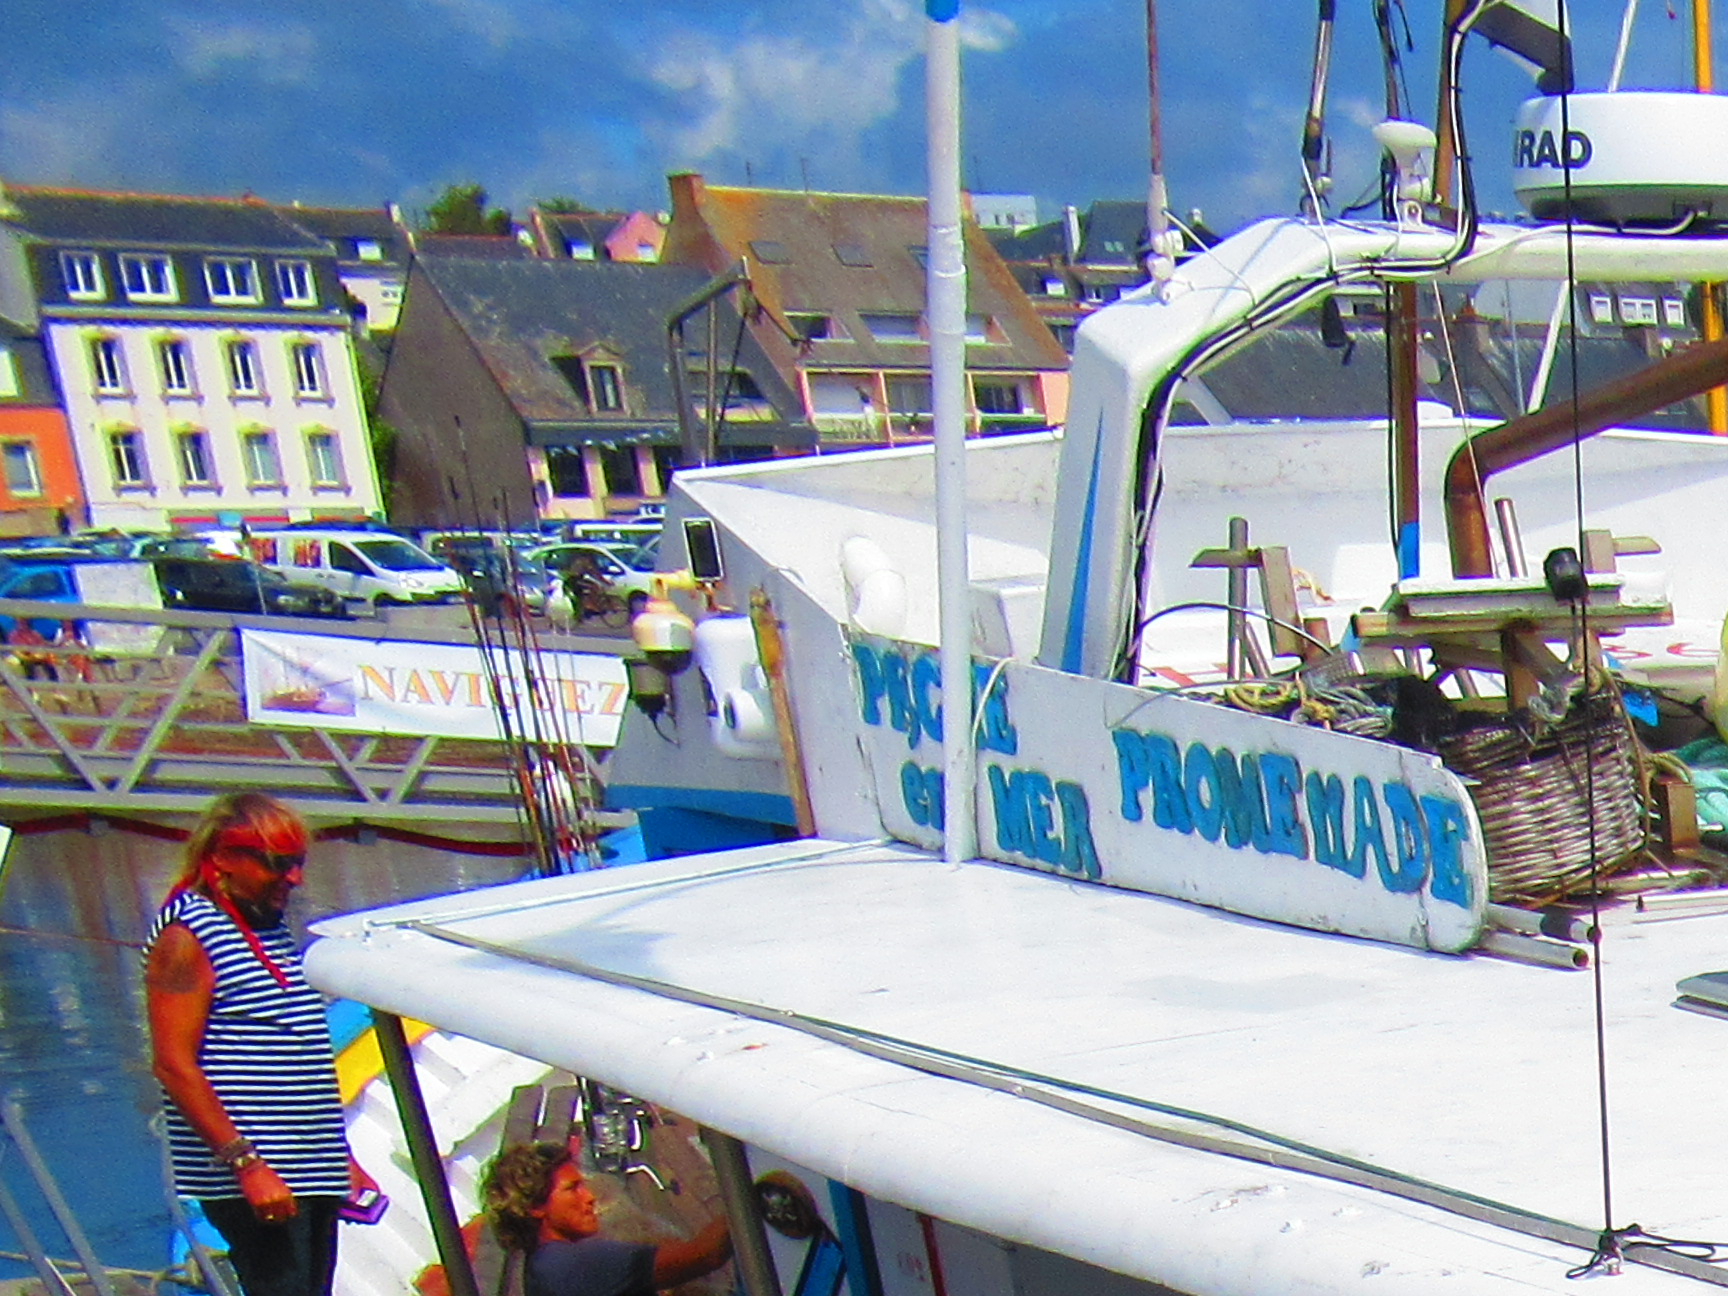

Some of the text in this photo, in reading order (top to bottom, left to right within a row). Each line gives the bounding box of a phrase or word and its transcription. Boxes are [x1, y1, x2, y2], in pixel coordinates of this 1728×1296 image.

[358, 664, 627, 716] NAVIGUEZ
[986, 762, 1103, 880] MER
[1112, 727, 1474, 910] PROMENADE
